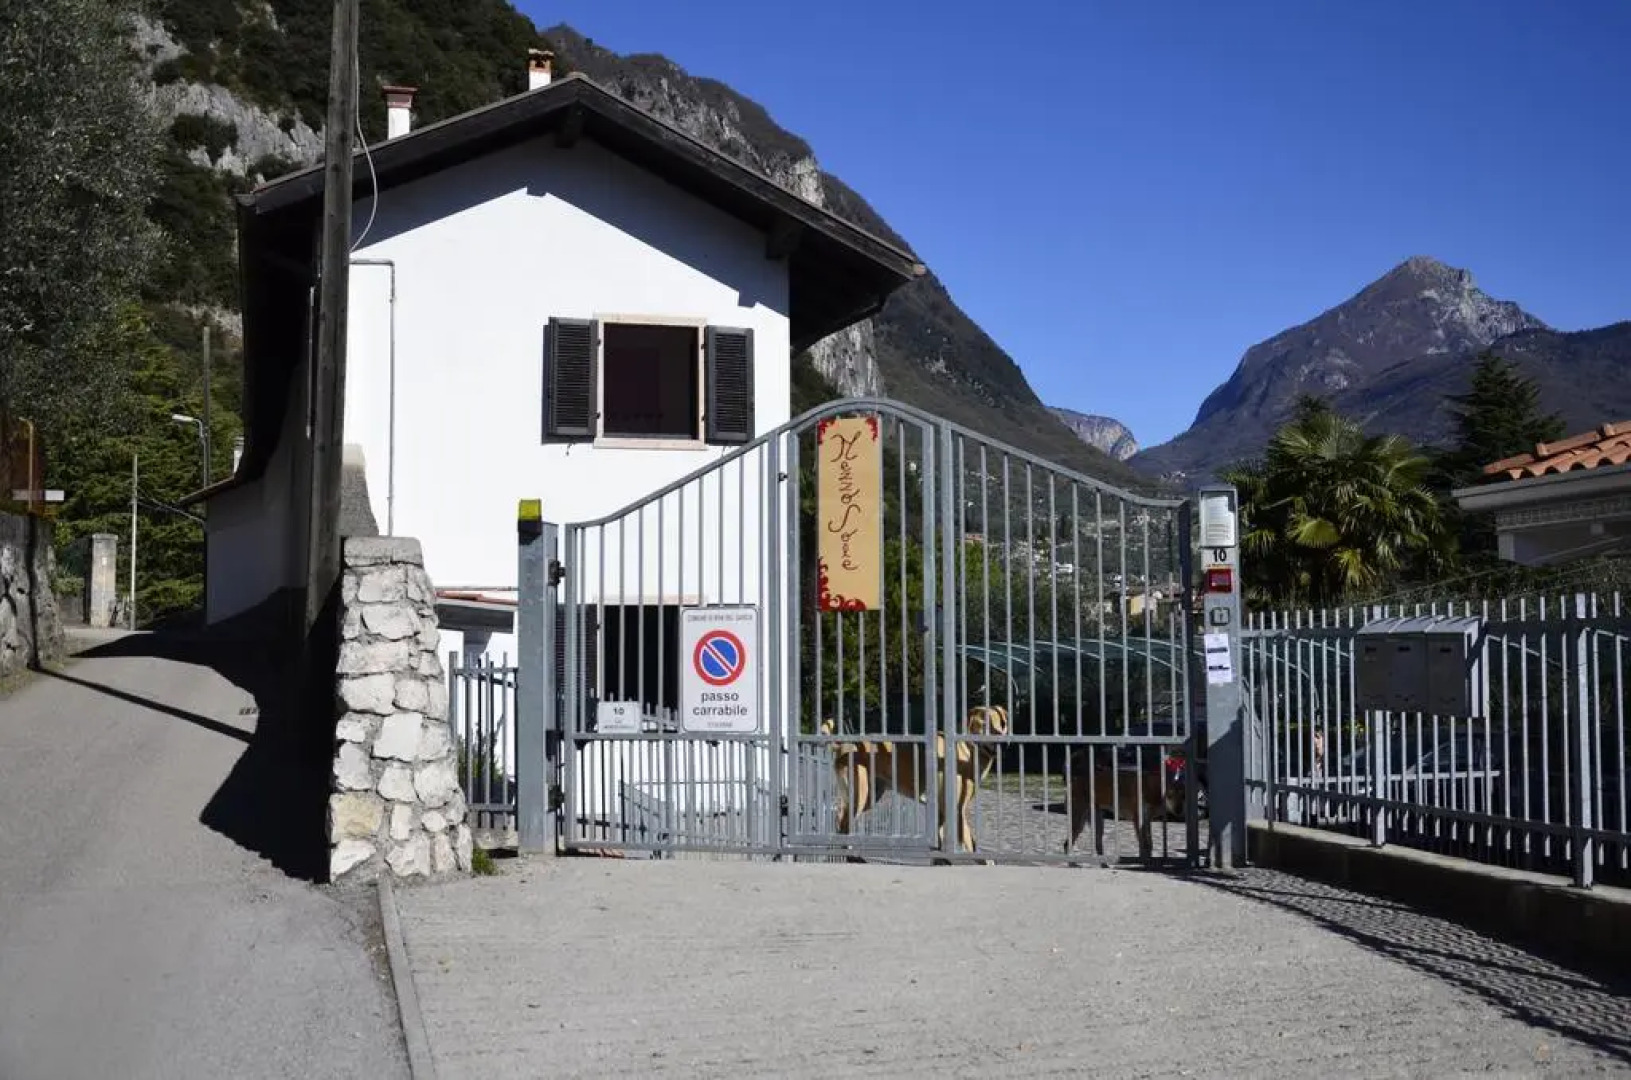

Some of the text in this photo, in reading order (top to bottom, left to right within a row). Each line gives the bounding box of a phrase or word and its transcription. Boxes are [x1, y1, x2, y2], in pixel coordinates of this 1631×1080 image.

[1213, 547, 1228, 563] 10
[700, 692, 740, 703] passo
[692, 704, 748, 716] carrabile
